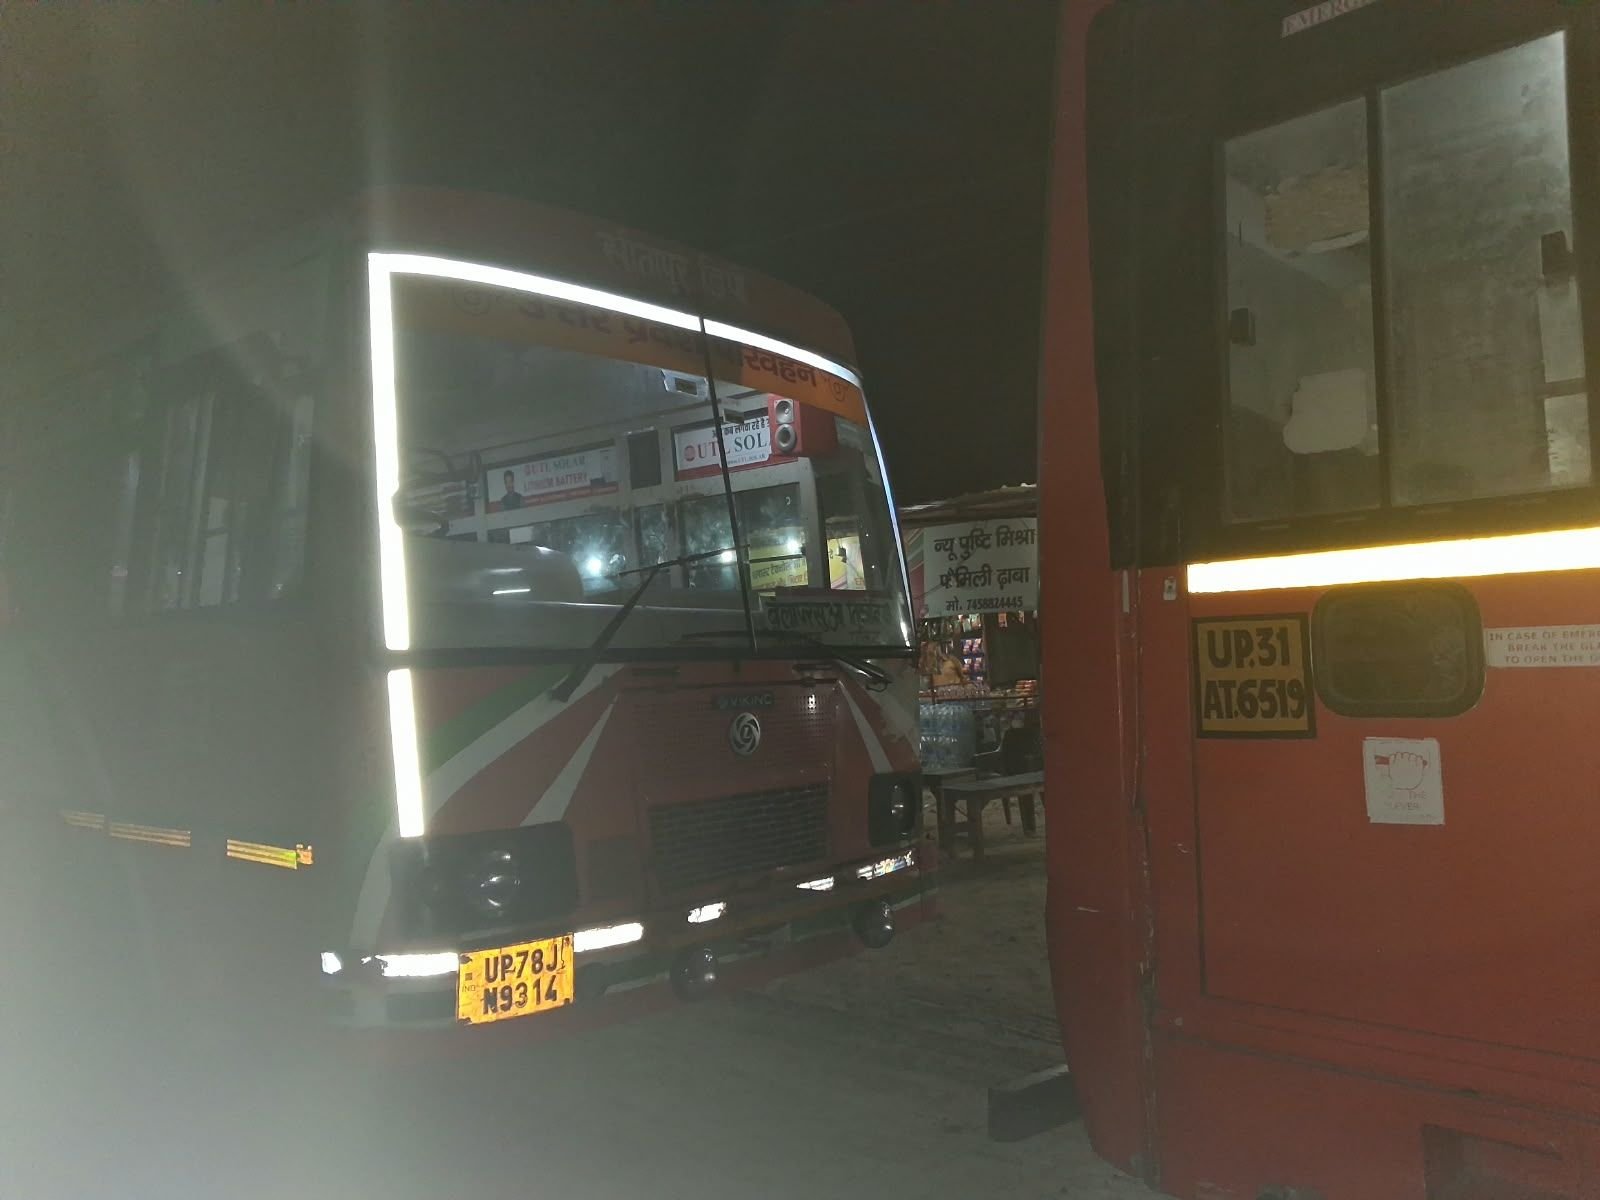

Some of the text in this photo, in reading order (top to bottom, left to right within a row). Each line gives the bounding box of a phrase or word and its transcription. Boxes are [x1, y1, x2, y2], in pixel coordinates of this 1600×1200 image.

[556, 472, 588, 486] BATTERY
[934, 524, 1036, 561] न्यू पुष्टि मिश्रा
[966, 596, 1024, 611] 7458824445
[1489, 633, 1503, 642] IN
[1507, 631, 1538, 641] CASE
[1542, 630, 1558, 640] OF
[1206, 626, 1291, 669] UP.31
[1508, 643, 1547, 652] BREAK
[1553, 642, 1575, 652] THE
[1505, 655, 1521, 665] TO
[1523, 655, 1558, 665] OPEN
[1562, 654, 1584, 664] THE
[730, 693, 772, 706] VIKING
[1202, 678, 1305, 720] AT.6519
[484, 943, 559, 984] UP78J
[462, 985, 476, 993] IND
[482, 974, 559, 1016] N9314
